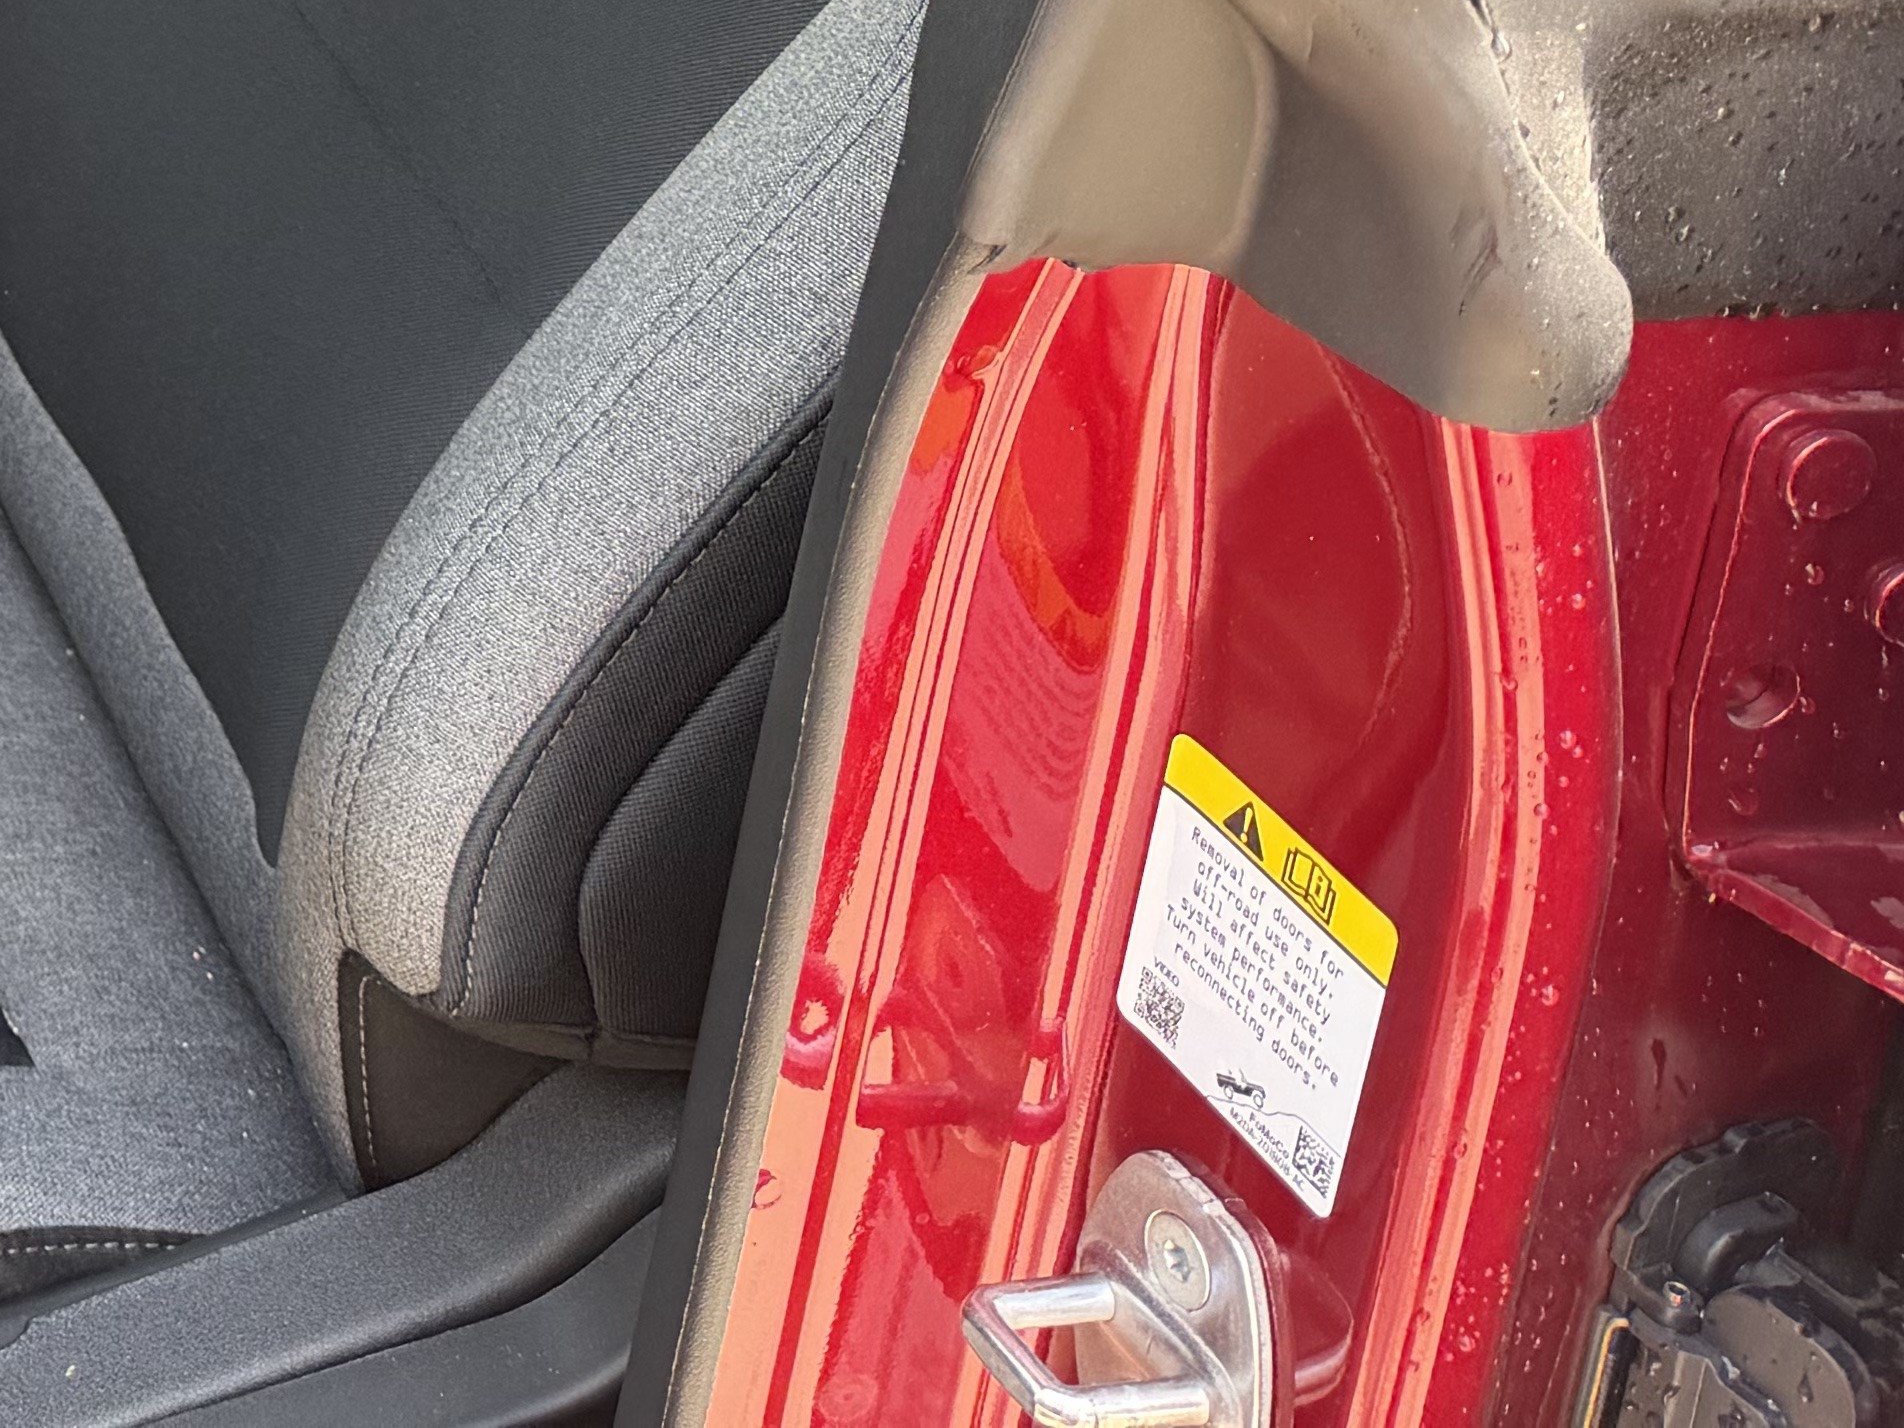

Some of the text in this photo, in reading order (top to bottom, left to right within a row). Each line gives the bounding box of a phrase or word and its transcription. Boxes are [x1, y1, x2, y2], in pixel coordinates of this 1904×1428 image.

[1181, 897, 1323, 1043] system performance.
[1192, 826, 1345, 979] Removal of doors for
[1193, 878, 1331, 1025] Will affect safety
[1198, 861, 1334, 1000] off-road use only.
[1167, 904, 1339, 1087] Turn vehicle off before
[1174, 943, 1317, 1091] reconnecting doors.
